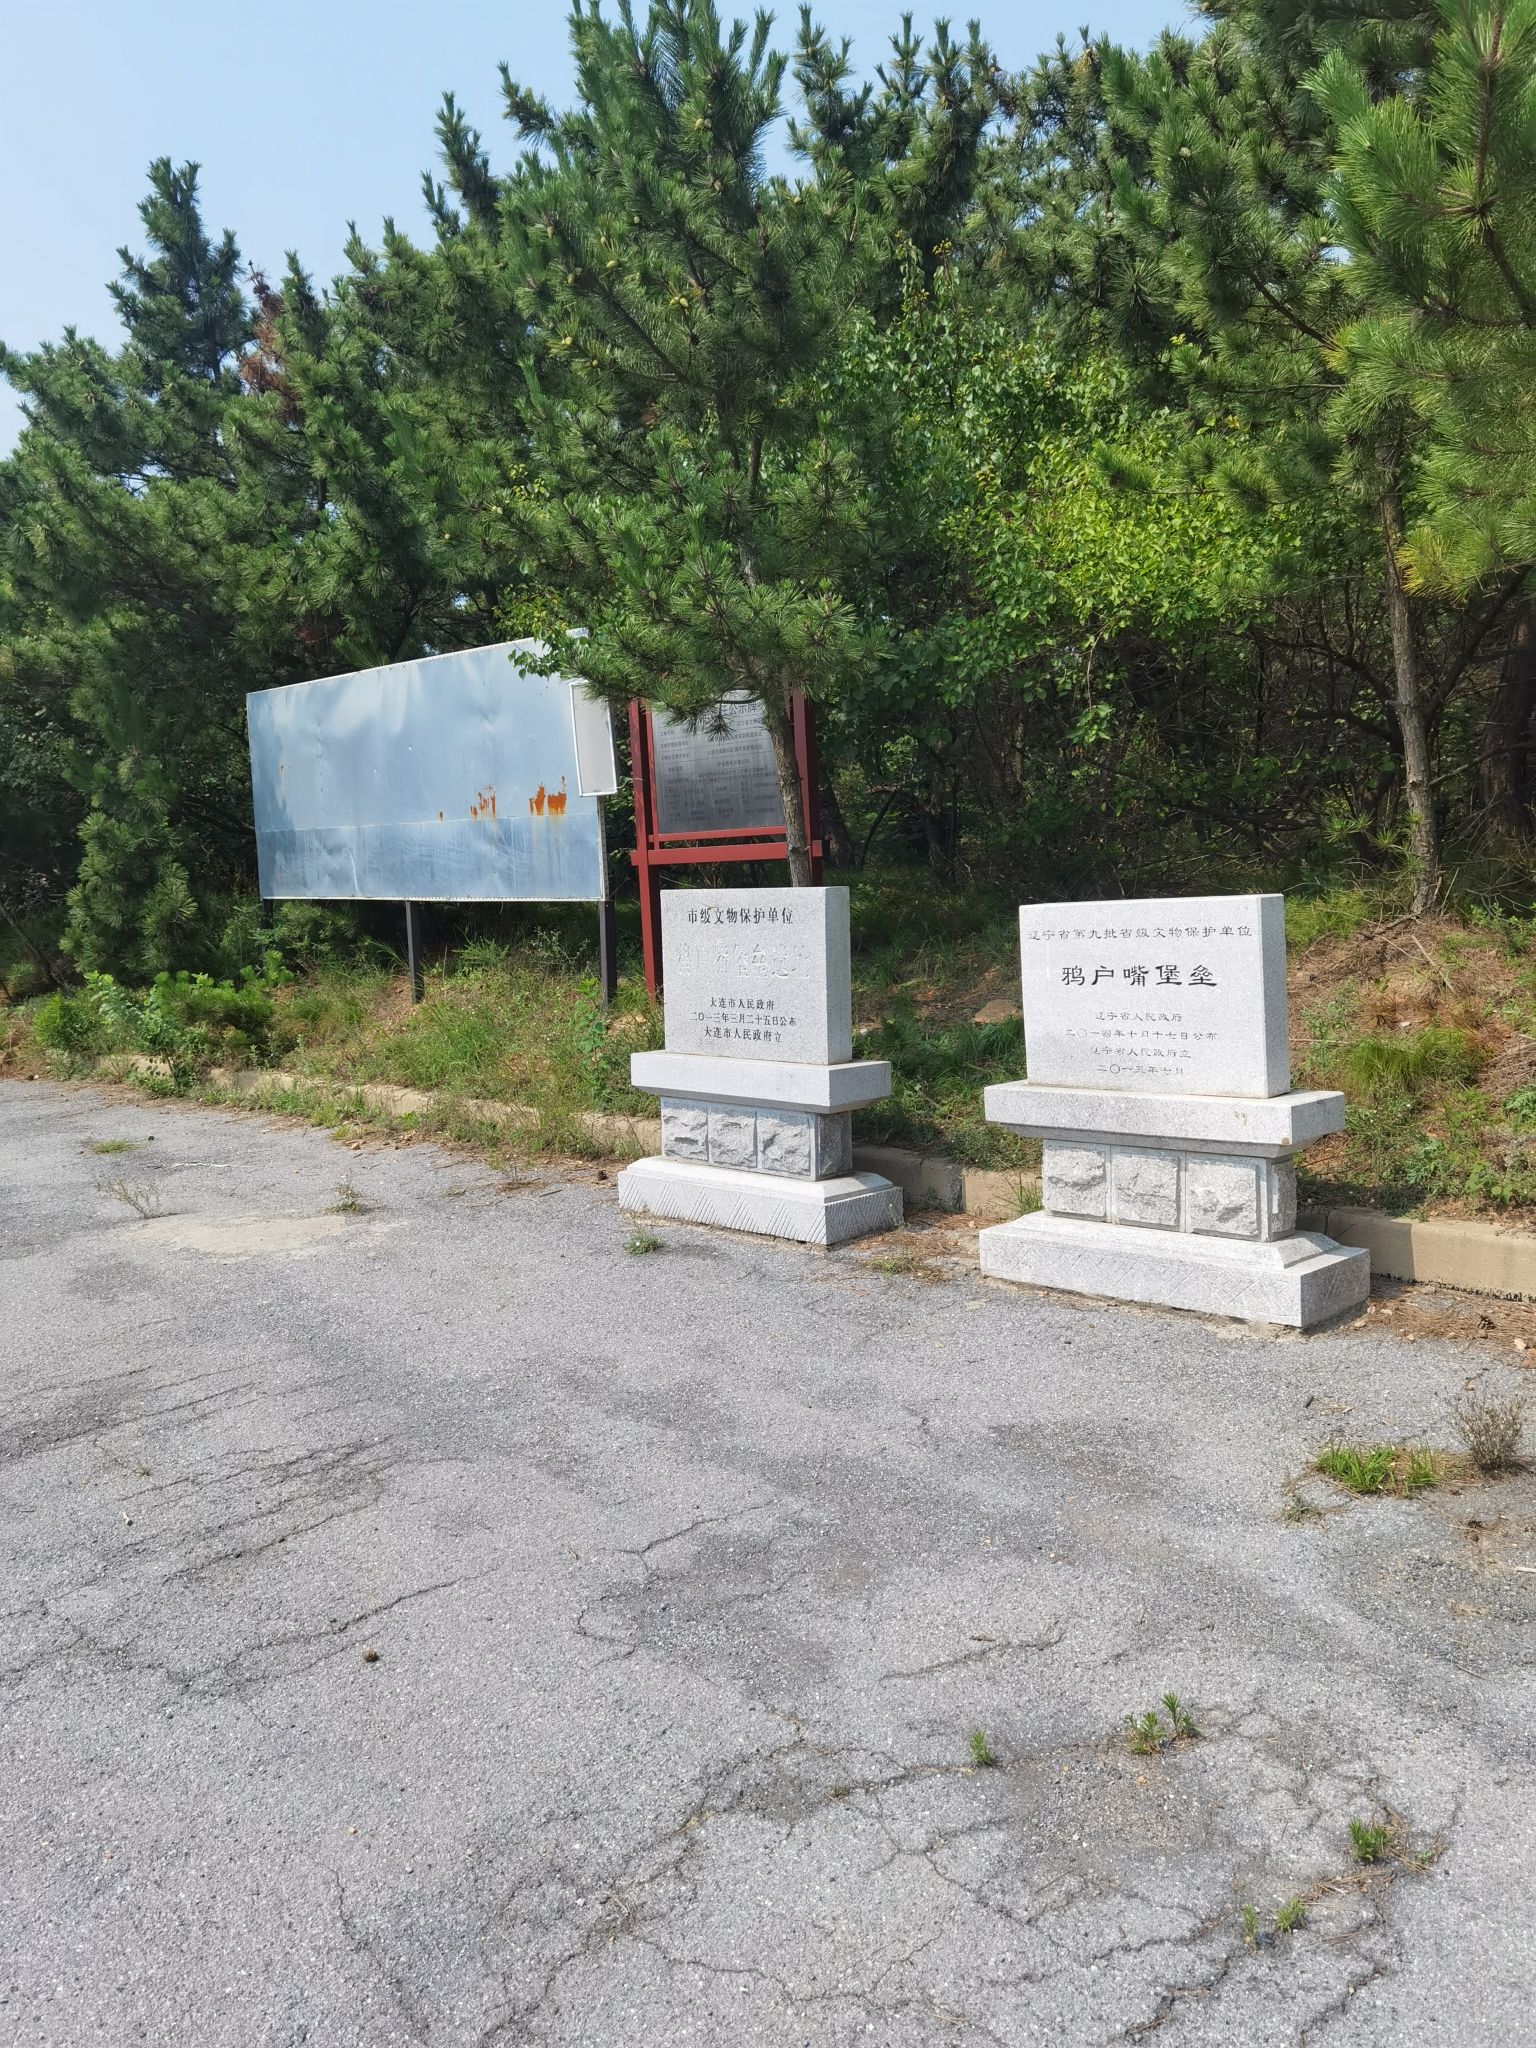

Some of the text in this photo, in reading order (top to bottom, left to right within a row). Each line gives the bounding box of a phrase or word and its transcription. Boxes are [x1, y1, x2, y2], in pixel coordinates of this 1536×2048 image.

[687, 907, 794, 925] 市级文物保护单位
[1028, 926, 1253, 941] 辽宁省第九批省级文物保护单位
[1060, 964, 1218, 987] 鸦户嘴堡垒
[709, 997, 775, 1010] 大连市人民政府
[1095, 1011, 1183, 1023] 辽宁省人民政府
[704, 1026, 783, 1043] 大连市人民政府立
[1090, 1046, 1192, 1059] 辽宁省人民政府立
